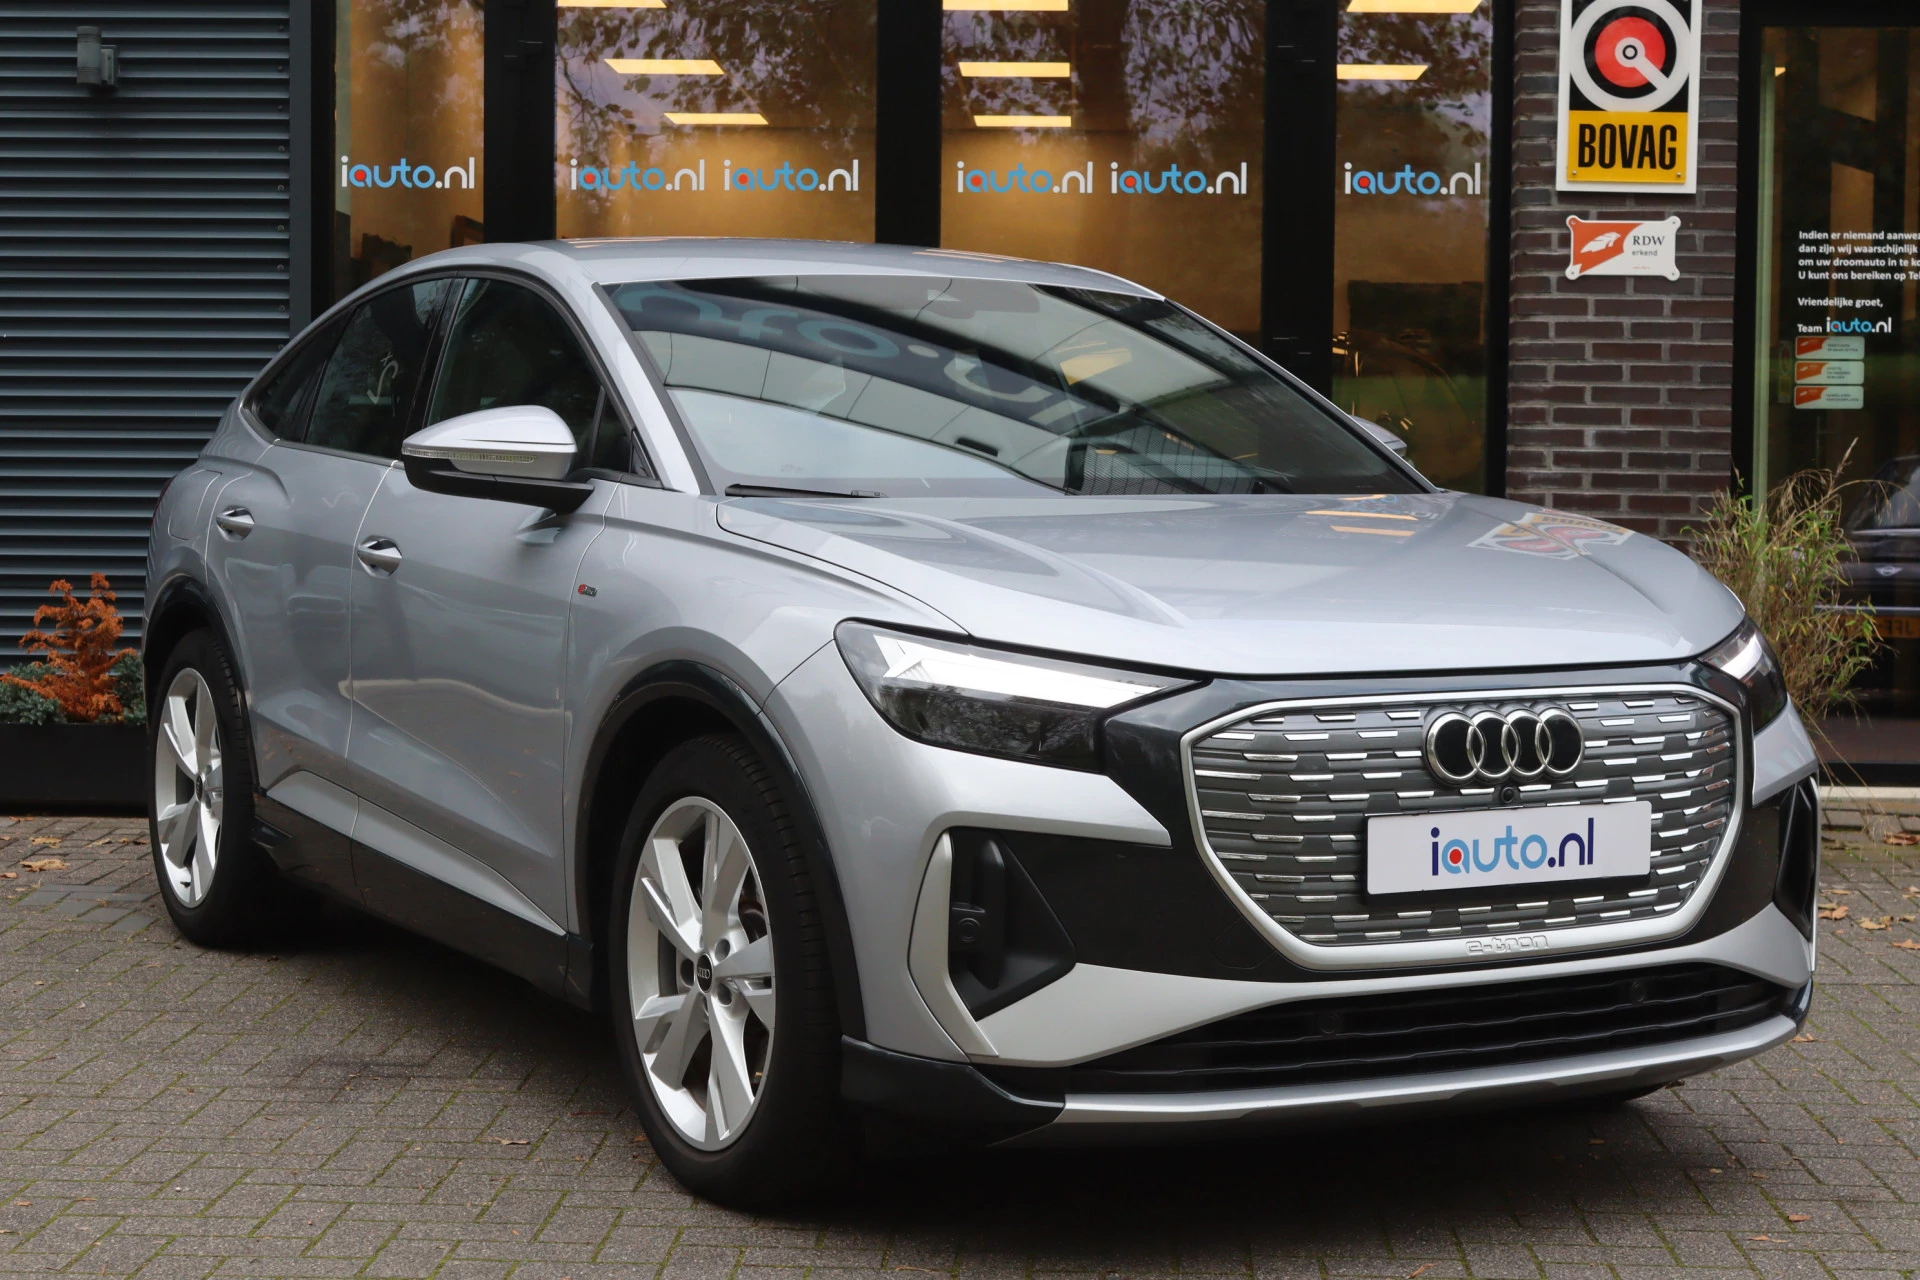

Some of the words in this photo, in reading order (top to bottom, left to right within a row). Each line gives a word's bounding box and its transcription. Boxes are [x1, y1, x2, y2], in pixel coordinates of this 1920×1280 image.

[1577, 123, 1678, 170] BOVAG
[341, 155, 475, 189] iauto.nl
[570, 158, 705, 192] iauto.nl
[723, 159, 859, 192] iauto.nl
[956, 161, 1094, 194] iauto.nl
[1110, 161, 1248, 195] iauto.nl
[1344, 161, 1481, 195] iauto.nl
[1632, 235, 1666, 246] RDW
[1799, 230, 1829, 240] Indien
[1830, 232, 1841, 240] er
[1843, 230, 1885, 240] niemand
[1631, 249, 1658, 257] erkend
[1798, 244, 1817, 253] dan
[1818, 244, 1835, 255] zijn
[1837, 244, 1852, 255] wij
[1853, 244, 1918, 255] waarschijnlijk
[1798, 258, 1814, 267] om
[1815, 259, 1831, 267] uw
[1832, 257, 1886, 267] droomauto
[1887, 257, 1897, 267] in
[1899, 258, 1909, 267] te
[1798, 270, 1806, 280] U
[1807, 270, 1830, 280] kunt
[1831, 272, 1849, 280] ons
[1850, 270, 1892, 280] bereiken
[1893, 272, 1907, 282] op
[1797, 297, 1854, 309] Vriendelijke
[1855, 298, 1884, 309] groet,
[1797, 323, 1823, 333] Team
[1826, 316, 1893, 333] iauto.nl
[1430, 817, 1595, 876] iauto.nl
[1466, 935, 1549, 955] e-tron
